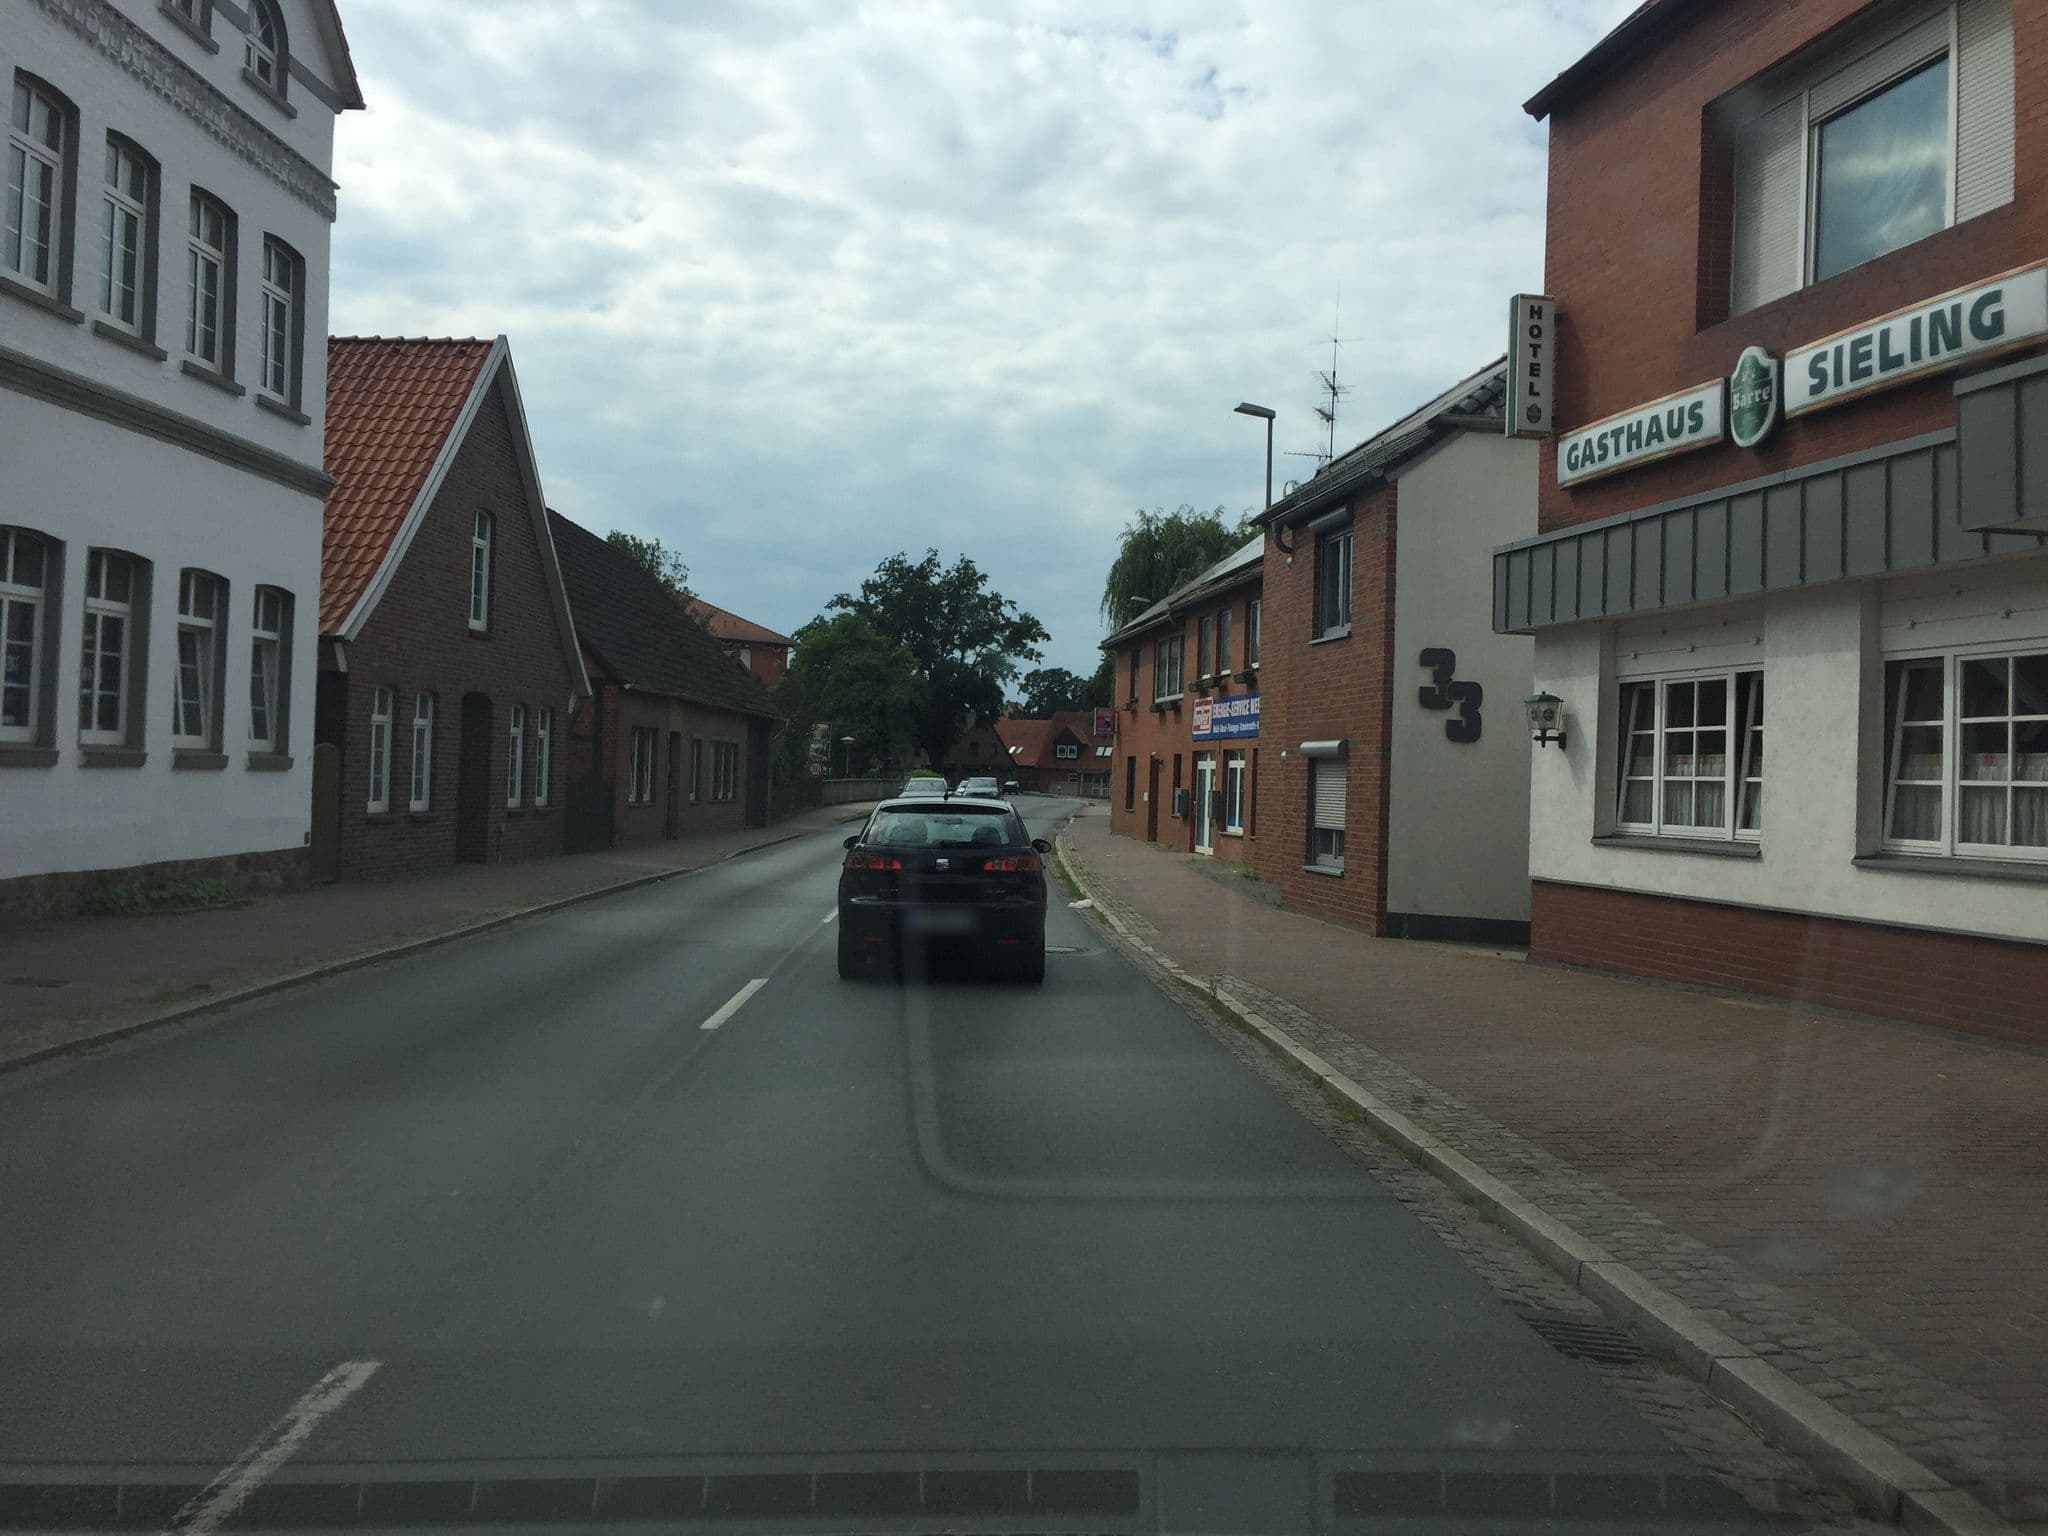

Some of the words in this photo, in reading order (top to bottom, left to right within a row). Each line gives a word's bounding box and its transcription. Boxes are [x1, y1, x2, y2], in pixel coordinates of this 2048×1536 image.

[1528, 304, 1543, 397] HOTEL
[1808, 289, 2005, 397] SIELING
[1566, 399, 1704, 473] GASTHAUS
[1731, 384, 1770, 411] Barre
[1419, 647, 1483, 743] 33
